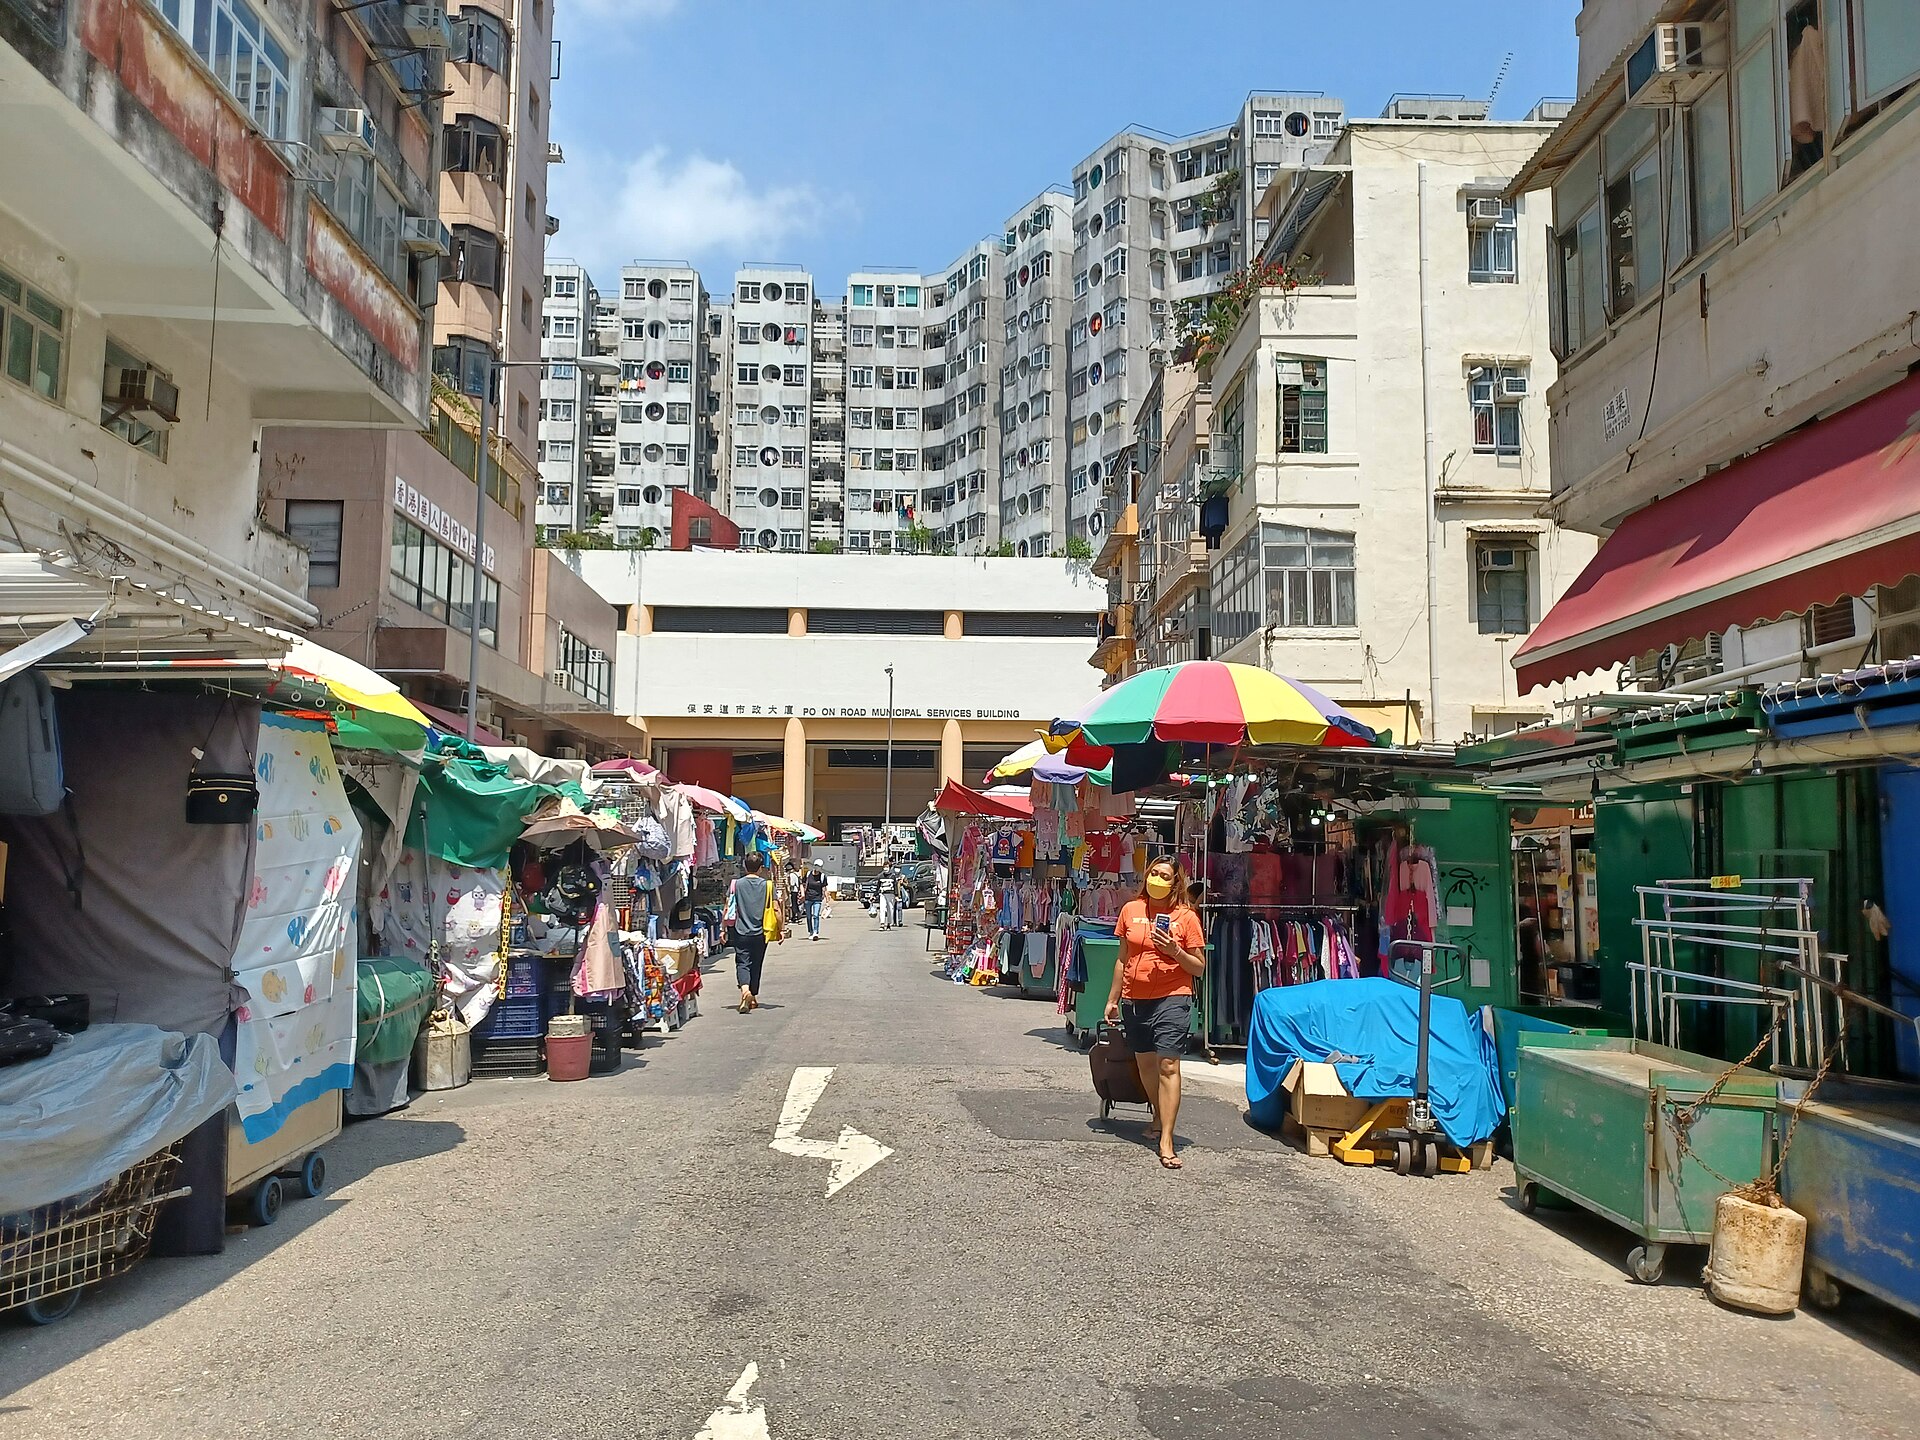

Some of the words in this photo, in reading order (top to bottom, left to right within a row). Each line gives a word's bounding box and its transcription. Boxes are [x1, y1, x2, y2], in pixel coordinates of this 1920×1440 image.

[687, 703, 794, 715] 保安道市政大廈
[803, 707, 816, 716] PO
[821, 707, 836, 716] ON
[840, 708, 867, 717] ROAD
[871, 708, 922, 717] MUNICIPAL
[926, 708, 972, 718] SERVICES
[976, 709, 1020, 718] BUILDING
